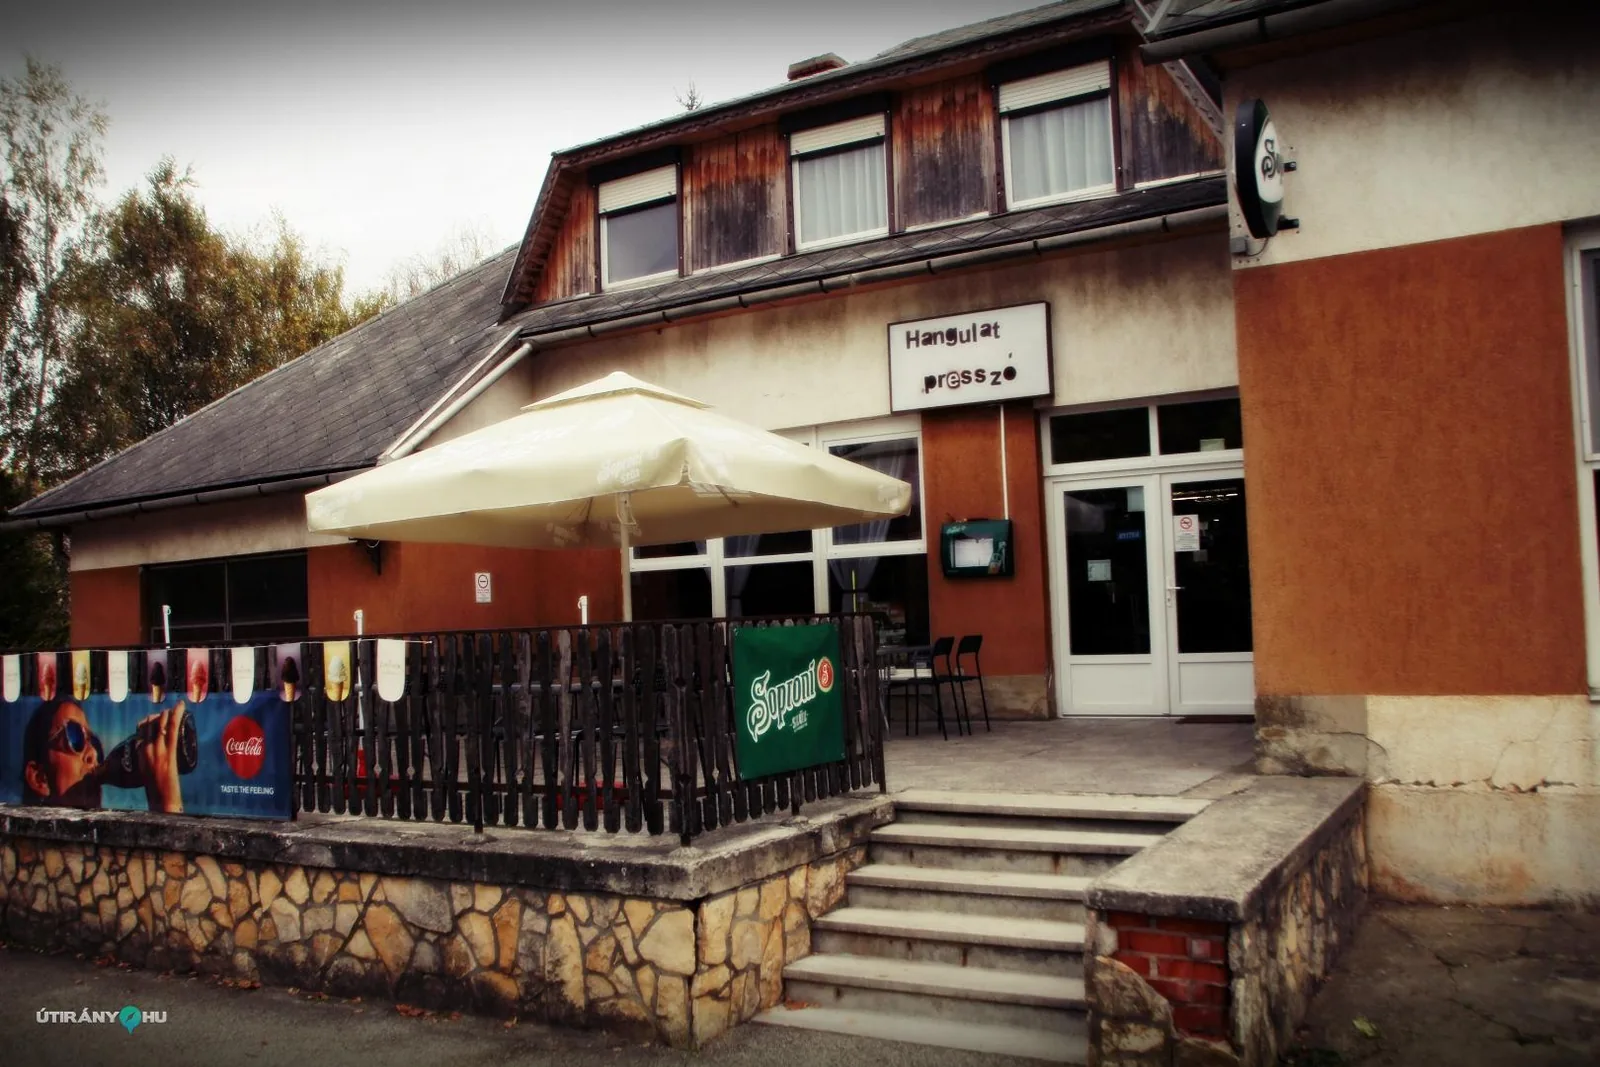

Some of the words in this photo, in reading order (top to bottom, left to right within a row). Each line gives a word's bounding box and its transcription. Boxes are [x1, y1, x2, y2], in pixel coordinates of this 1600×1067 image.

[905, 321, 1001, 349] Hangulat
[747, 658, 816, 743] Soproni
[225, 737, 264, 756] Coca-Cola
[220, 785, 239, 794] TASTE
[239, 785, 249, 794] THE
[249, 786, 275, 796] FEELING
